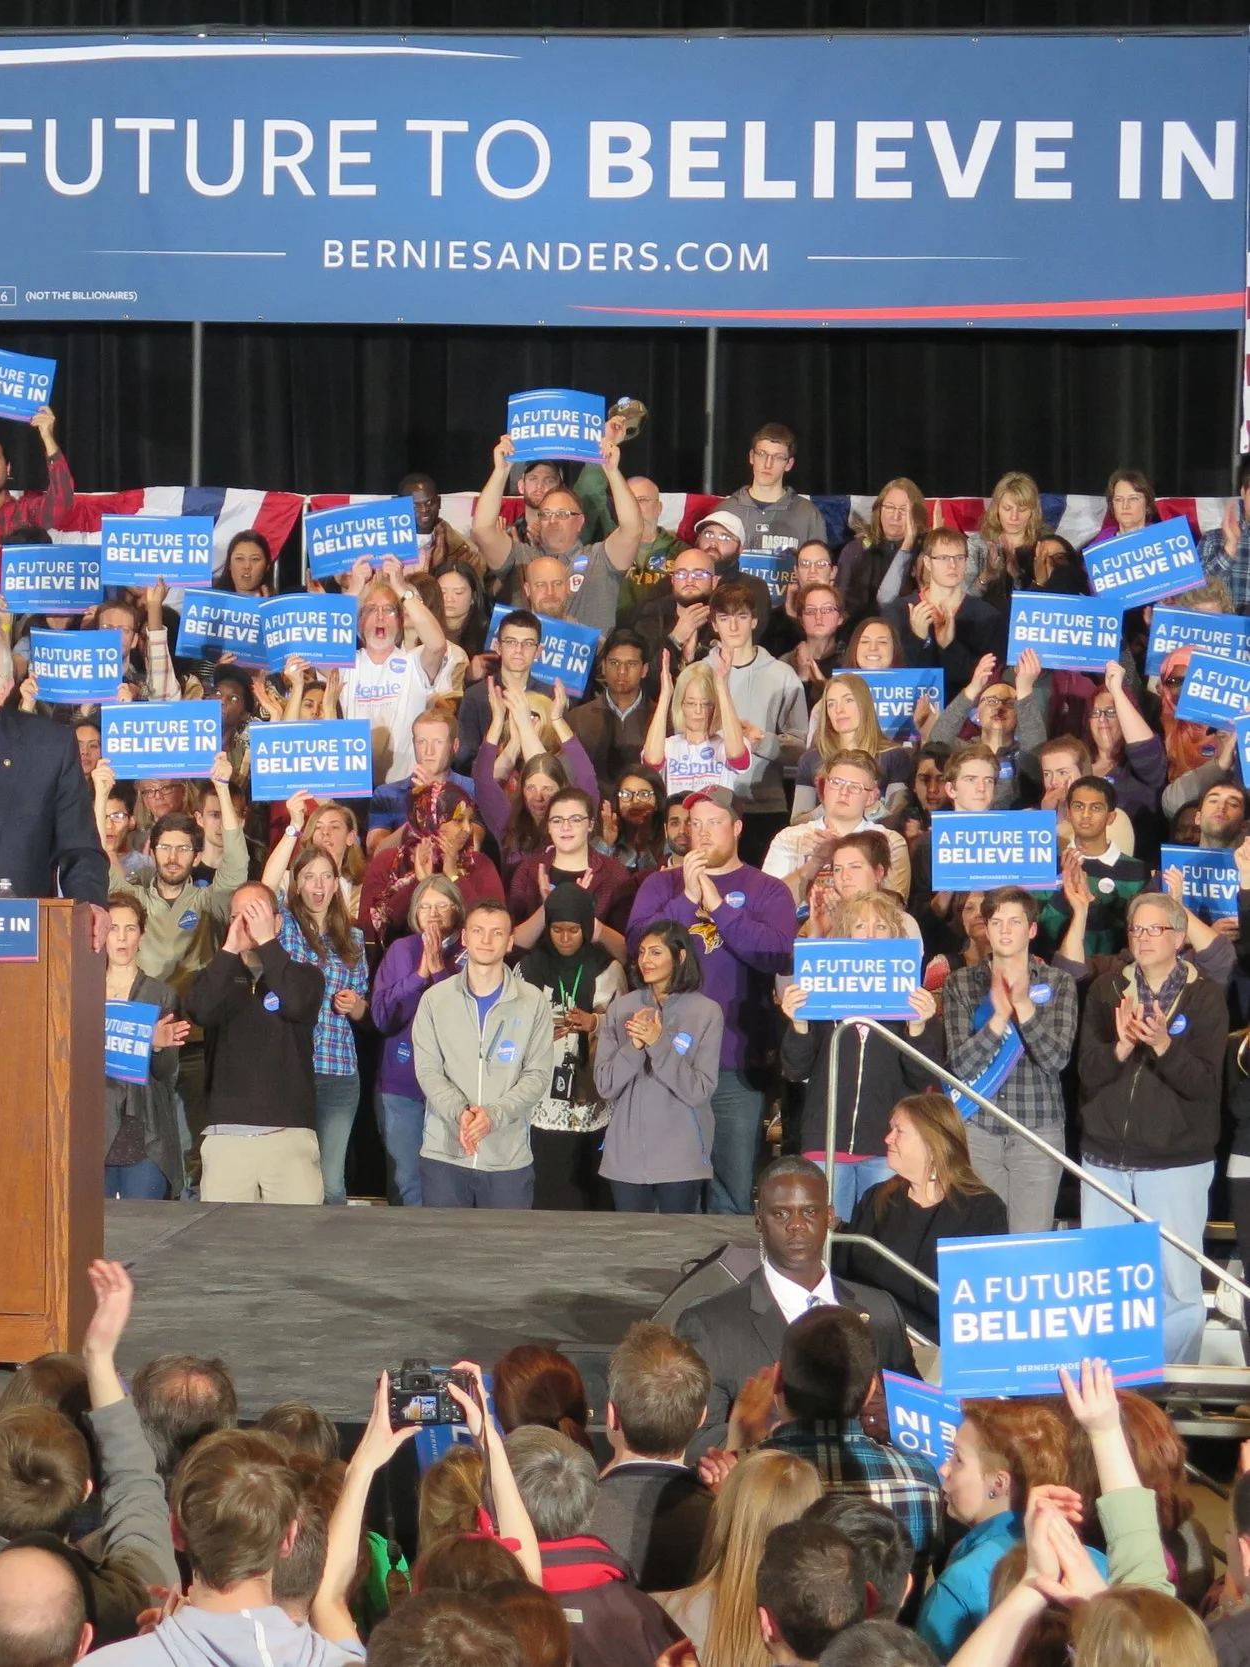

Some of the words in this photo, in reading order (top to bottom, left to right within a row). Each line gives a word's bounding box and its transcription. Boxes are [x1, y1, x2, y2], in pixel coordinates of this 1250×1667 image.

[405, 119, 551, 200] TO
[588, 120, 1073, 200] BELIEVE
[1118, 120, 1236, 200] IN
[323, 239, 768, 272] BERNIESANDERS.COM
[25, 291, 50, 302] (NOT
[51, 291, 70, 300] THE
[71, 290, 137, 302] BILLIONAIRES)
[28, 372, 49, 386] TO
[27, 387, 46, 402] IN
[511, 413, 520, 424] A
[523, 409, 579, 423] FUTURE
[582, 413, 601, 426] TO
[509, 423, 580, 442] BELIEVE
[583, 426, 602, 445] IN
[312, 528, 322, 540] A
[325, 517, 385, 537] FUTURE
[388, 514, 410, 527] TO
[107, 532, 118, 544] A
[121, 532, 182, 546] FUTURE
[186, 534, 209, 546] TO
[313, 531, 388, 556] BELIEVE
[392, 528, 413, 544] IN
[106, 546, 183, 563] BELIEVE
[188, 549, 208, 563] IN
[1092, 563, 1101, 576] A
[1102, 542, 1164, 571] FUTURE
[1164, 534, 1189, 550] TO
[5, 562, 15, 574] A
[17, 561, 74, 574] FUTURE
[78, 561, 99, 573] TO
[1093, 556, 1170, 592] BELIEVE
[1172, 549, 1195, 567] IN
[4, 575, 75, 590] BELIEVE
[80, 576, 99, 590] IN
[187, 604, 198, 617] A
[200, 605, 260, 626] FUTURE
[271, 611, 327, 628] FUTURE
[330, 612, 352, 626] TO
[1016, 610, 1028, 623] A
[1031, 610, 1093, 628] FUTURE
[1097, 616, 1118, 630] TO
[184, 618, 259, 643] BELIEVE
[266, 626, 327, 648] BELIEVE
[332, 628, 352, 644] IN
[1014, 625, 1092, 645] BELIEVE
[1097, 632, 1116, 647] IN
[1156, 624, 1168, 636] A
[1170, 626, 1232, 645] FUTURE
[41, 647, 92, 662] FUTURE
[95, 648, 118, 661] TO
[34, 660, 93, 678] BELIEVE
[98, 663, 118, 678] IN
[1192, 668, 1202, 680] A
[107, 721, 119, 734] A
[122, 719, 188, 734] FUTURE
[192, 719, 216, 732] TO
[106, 736, 189, 753] BELIEVE
[194, 735, 216, 751] IN
[256, 741, 268, 755] A
[271, 738, 338, 754] FUTURE
[341, 738, 366, 752] TO
[256, 755, 339, 774] BELIEVE
[344, 754, 366, 770] IN
[668, 758, 724, 776] Bernie
[938, 831, 950, 844] A
[954, 830, 1022, 844] FUTURE
[1027, 830, 1052, 844] TO
[938, 847, 1024, 863] BELIEVE
[1029, 847, 1051, 862] IN
[9, 917, 30, 932] IN
[800, 959, 812, 973] A
[816, 959, 886, 973] FUTURE
[889, 959, 915, 973] TO
[800, 976, 886, 991] BELIEVE
[892, 976, 916, 992] IN
[952, 1278, 976, 1305] A
[984, 1267, 1111, 1303] FUTURE
[1116, 1262, 1154, 1291] TO
[951, 1301, 1114, 1343] BELIEVE
[1121, 1296, 1155, 1330] IN
